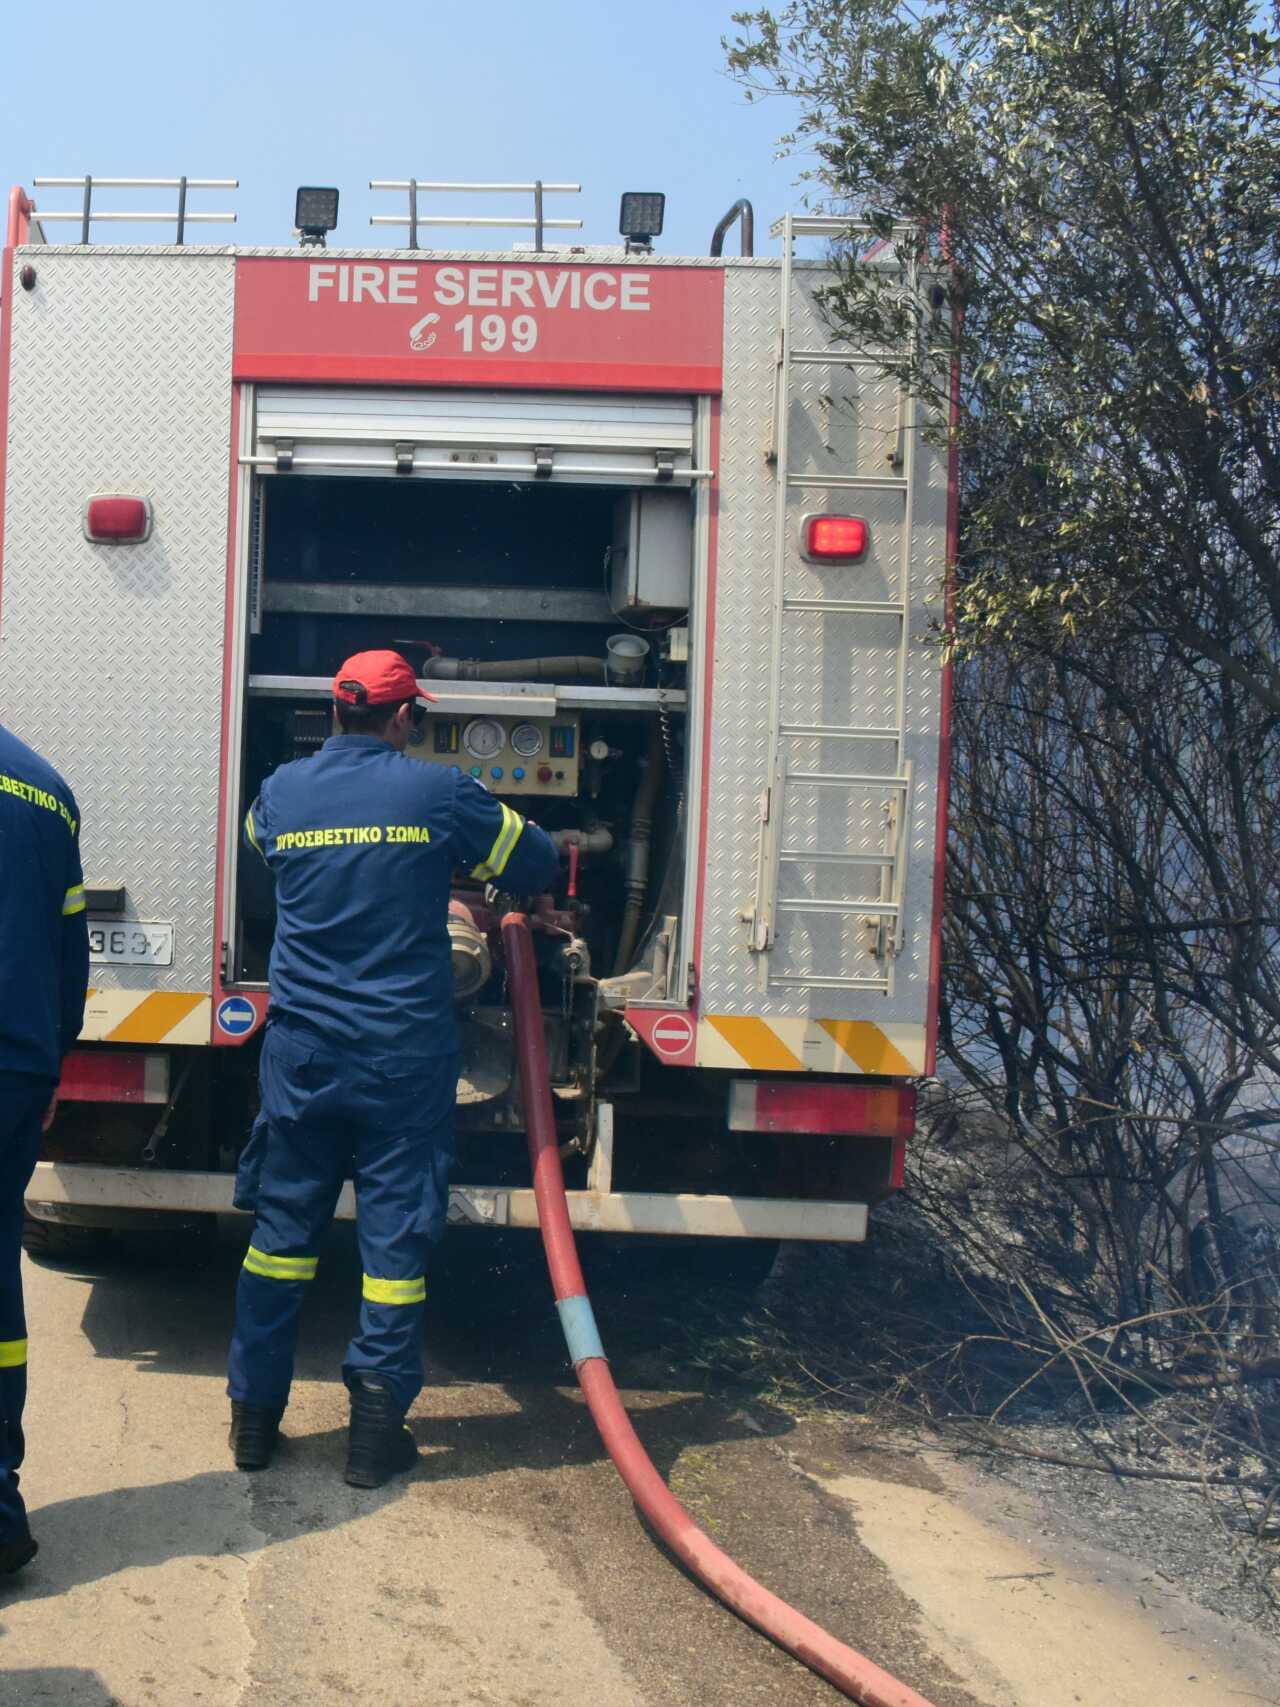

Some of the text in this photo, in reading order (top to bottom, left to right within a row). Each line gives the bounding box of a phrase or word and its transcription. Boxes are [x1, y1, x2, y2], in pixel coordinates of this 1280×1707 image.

[308, 264, 651, 311] FIRE SERVICE
[455, 314, 538, 353] 199
[276, 826, 430, 851] ΠΥΡΟΣΒΕΣΤΙΚΟ ΣΩΜΑ
